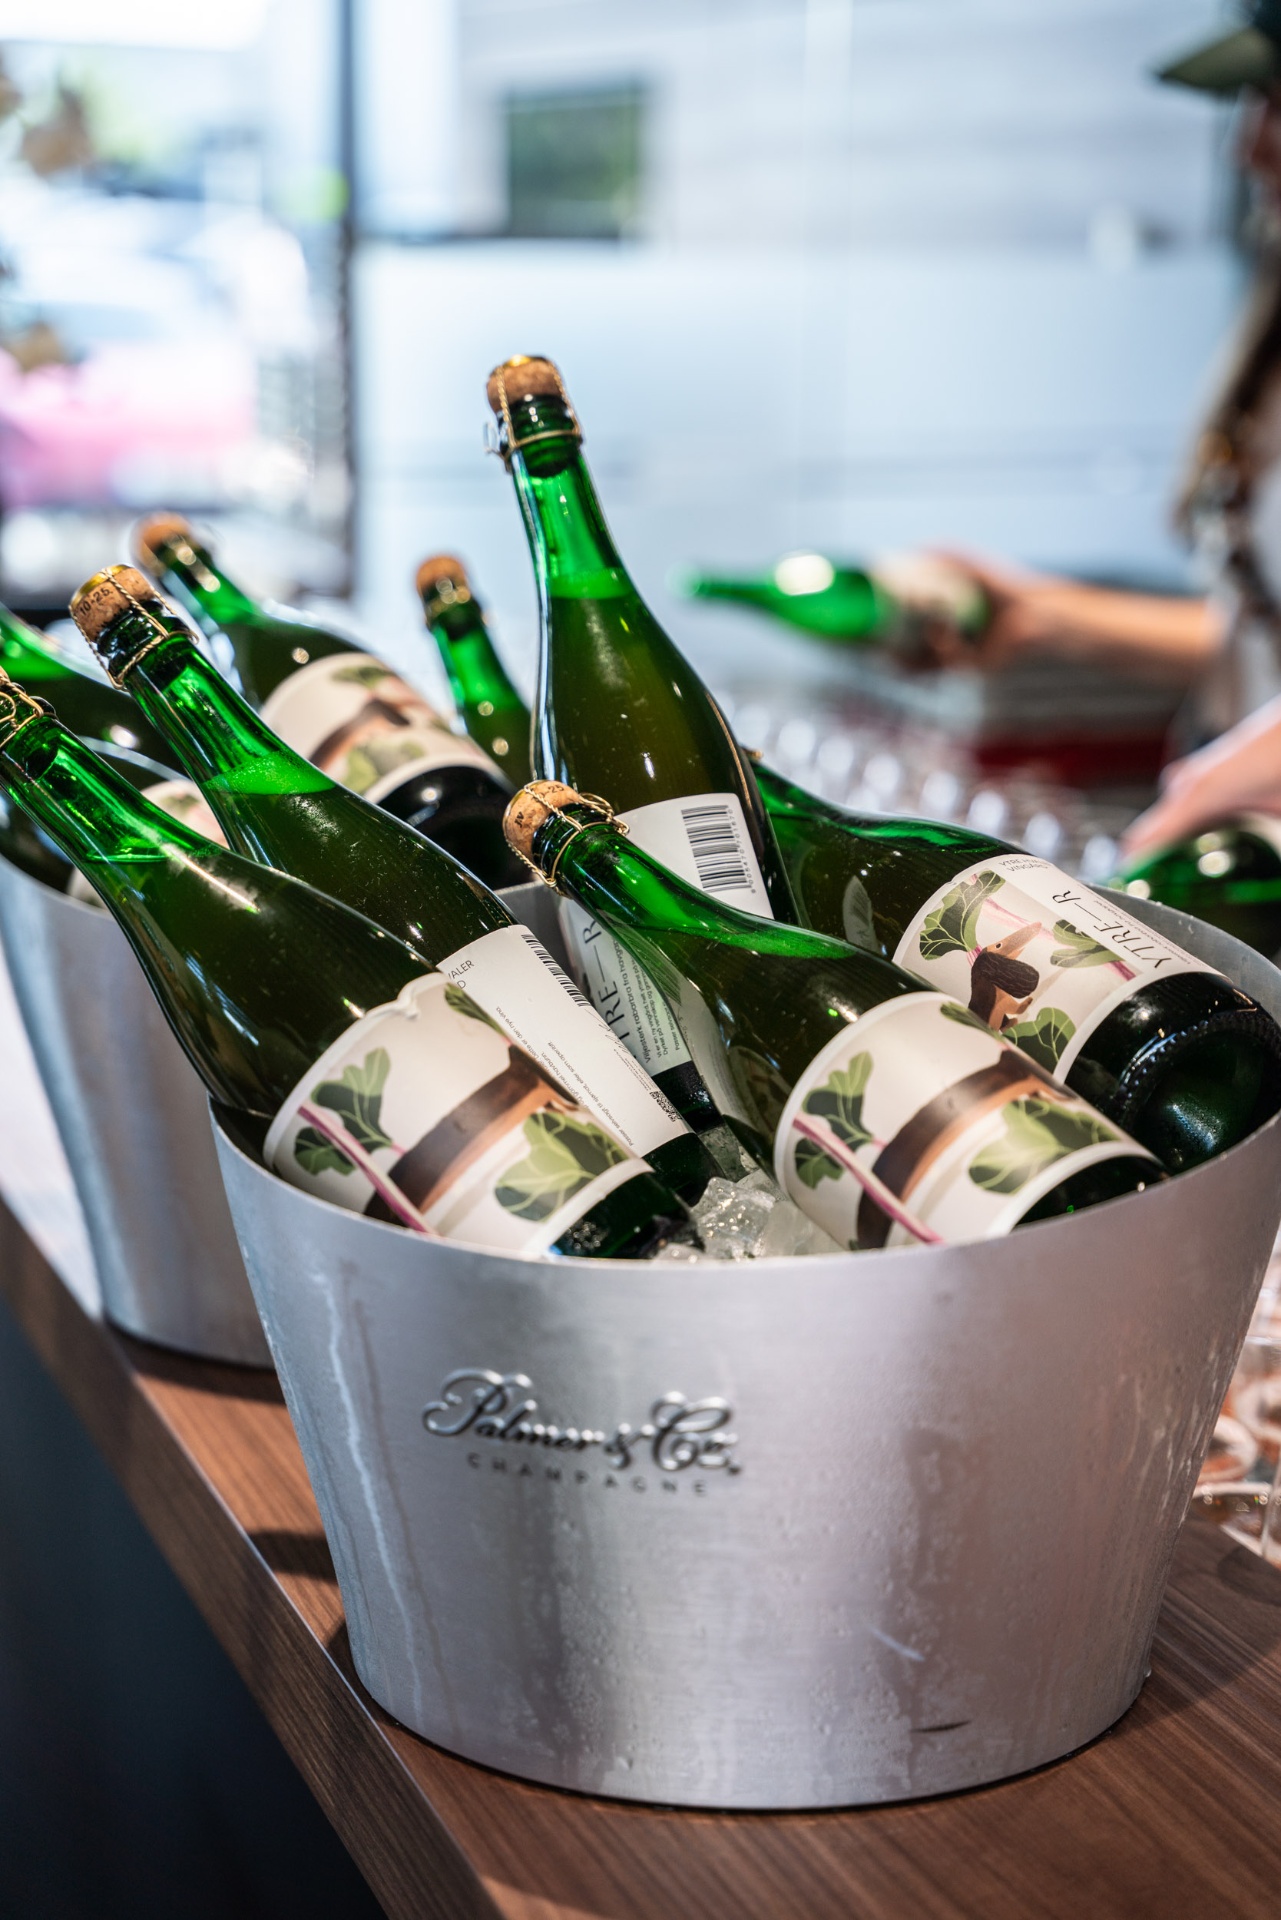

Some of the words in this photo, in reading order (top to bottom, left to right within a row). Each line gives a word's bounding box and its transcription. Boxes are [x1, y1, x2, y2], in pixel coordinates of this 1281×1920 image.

[620, 972, 630, 986] fra
[625, 986, 641, 1025] rabarbra
[423, 1367, 606, 1452] Palmer
[467, 1452, 706, 1497] CHAMPAGNE
